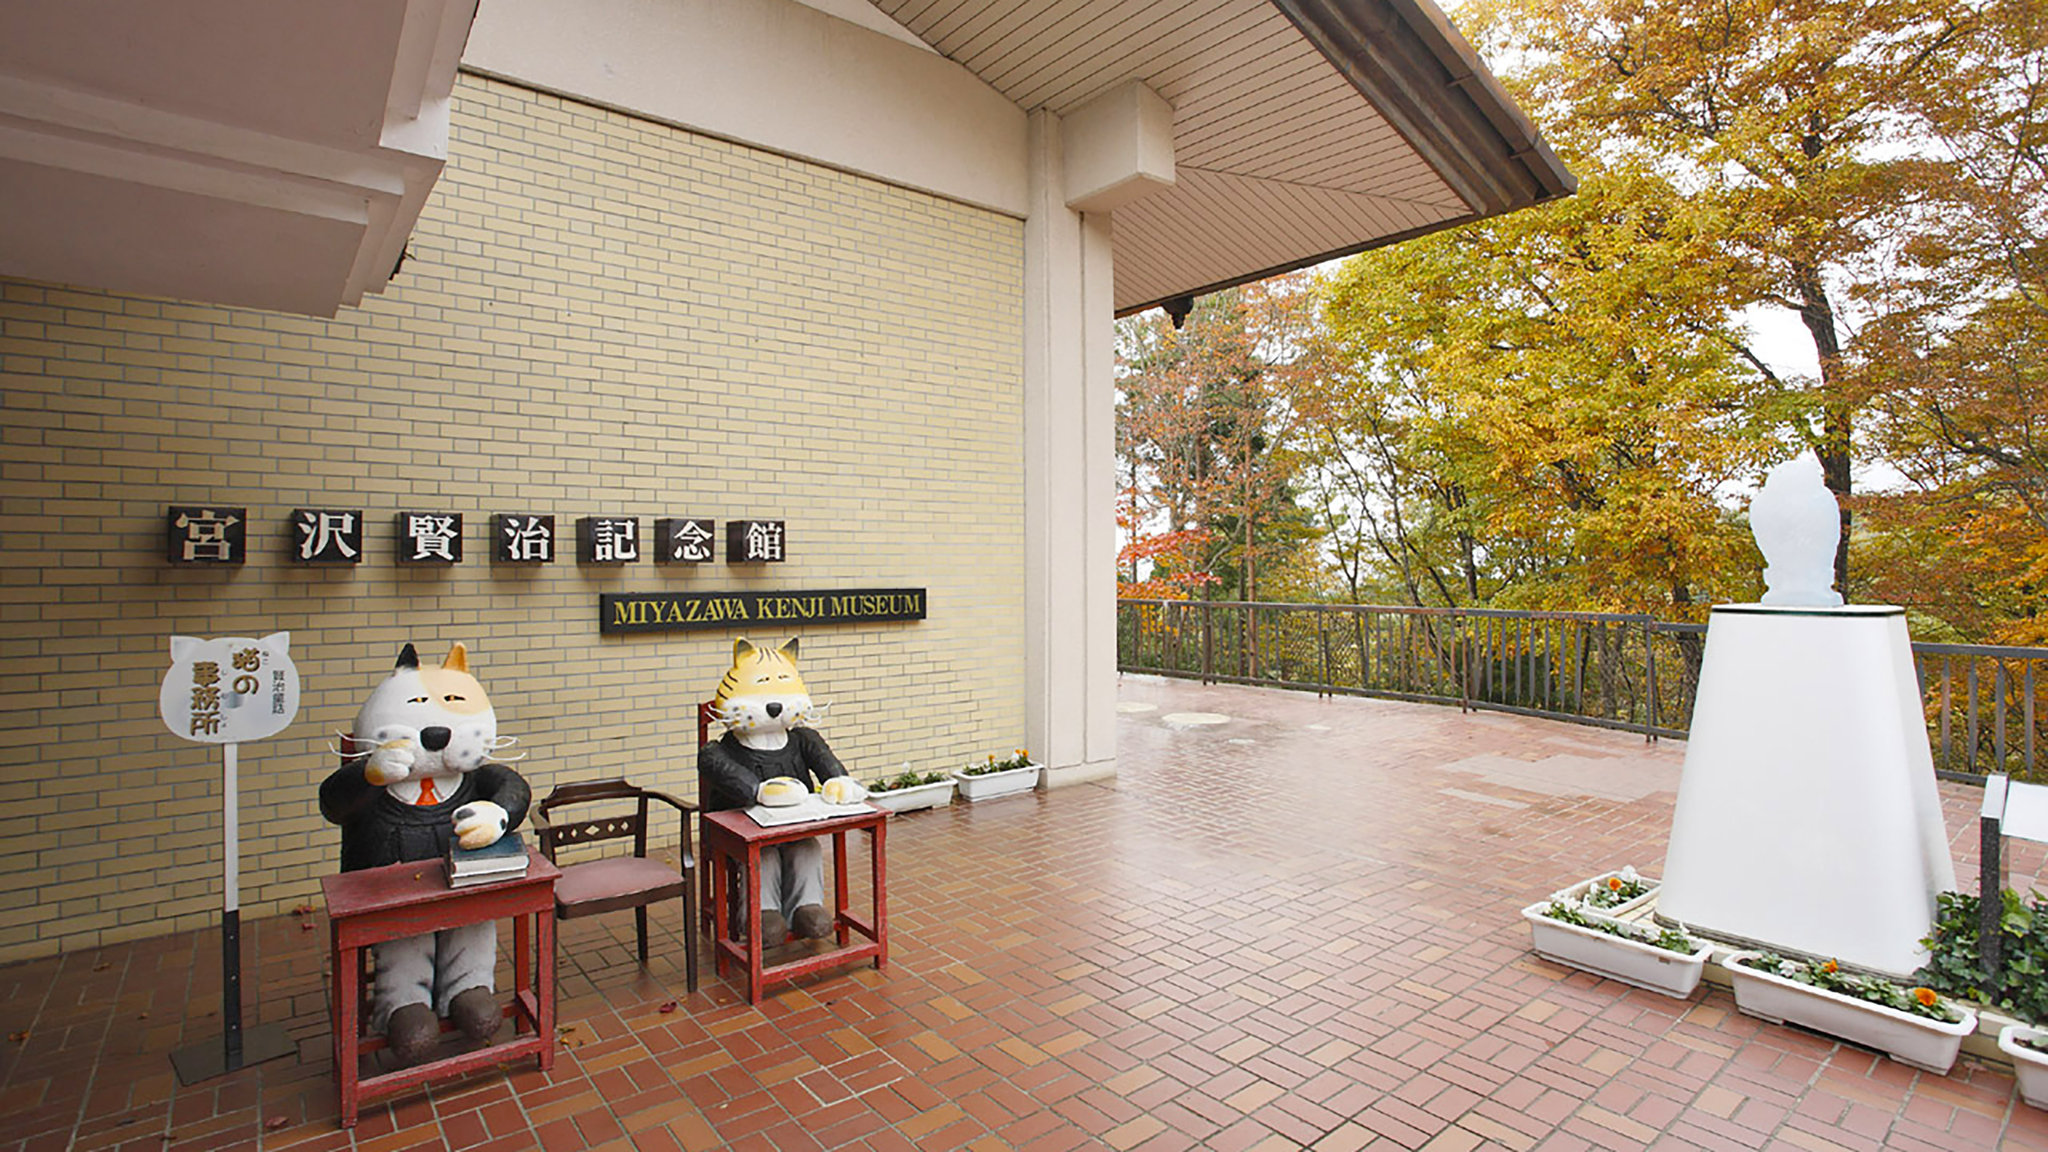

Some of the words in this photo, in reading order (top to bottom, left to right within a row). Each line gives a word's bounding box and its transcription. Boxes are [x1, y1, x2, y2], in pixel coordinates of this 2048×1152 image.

[175, 509, 783, 561] 宮沢賢治記念館
[613, 598, 749, 625] MIYAZAWA
[756, 596, 826, 620] KENJI
[830, 594, 921, 617] MUSEUM
[190, 661, 221, 736] 事務所
